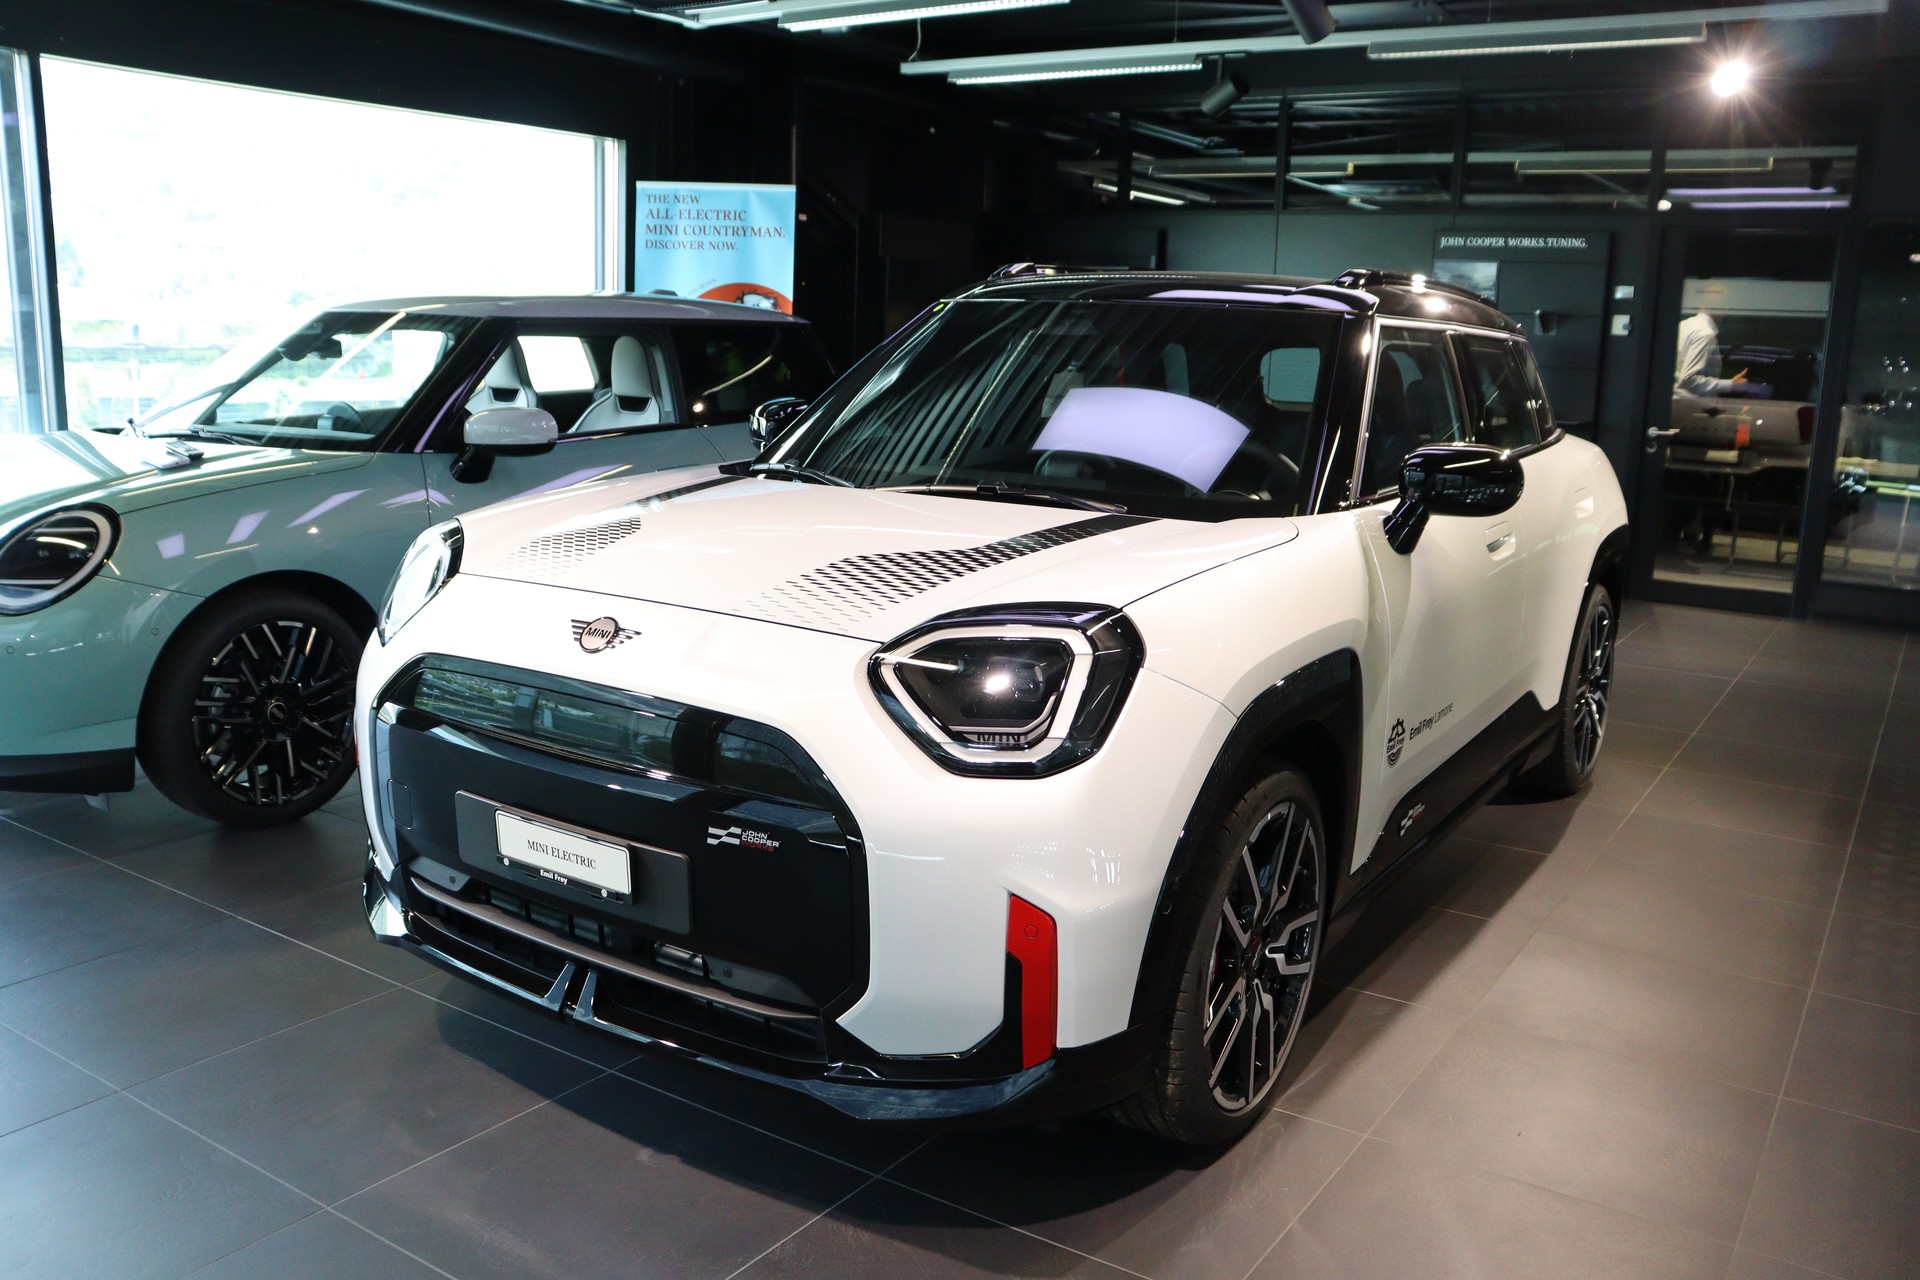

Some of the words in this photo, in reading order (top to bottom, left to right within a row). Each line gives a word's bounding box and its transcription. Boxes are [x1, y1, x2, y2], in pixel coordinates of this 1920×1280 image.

[646, 194, 669, 204] THE
[673, 194, 701, 204] NEW
[646, 208, 747, 221] ALL-ELECTRIC
[645, 223, 678, 236] MINI
[683, 224, 786, 238] COUNTRYMAN.
[645, 239, 704, 250] DISCOVER
[709, 240, 738, 251] NOW.
[1440, 236, 1465, 248] JOHN
[1467, 236, 1506, 247] COOPER
[1547, 237, 1588, 248] TUNING.
[585, 627, 611, 639] MINI
[1410, 722, 1422, 740] Emil
[1422, 716, 1434, 731] Frey
[742, 830, 768, 839] JOHN
[741, 836, 779, 848] COOPER
[741, 841, 775, 852] WORKS
[527, 839, 549, 855] MINI
[551, 845, 597, 869] ELECTRIC
[540, 869, 553, 880] Emil
[554, 872, 568, 885] Frey
